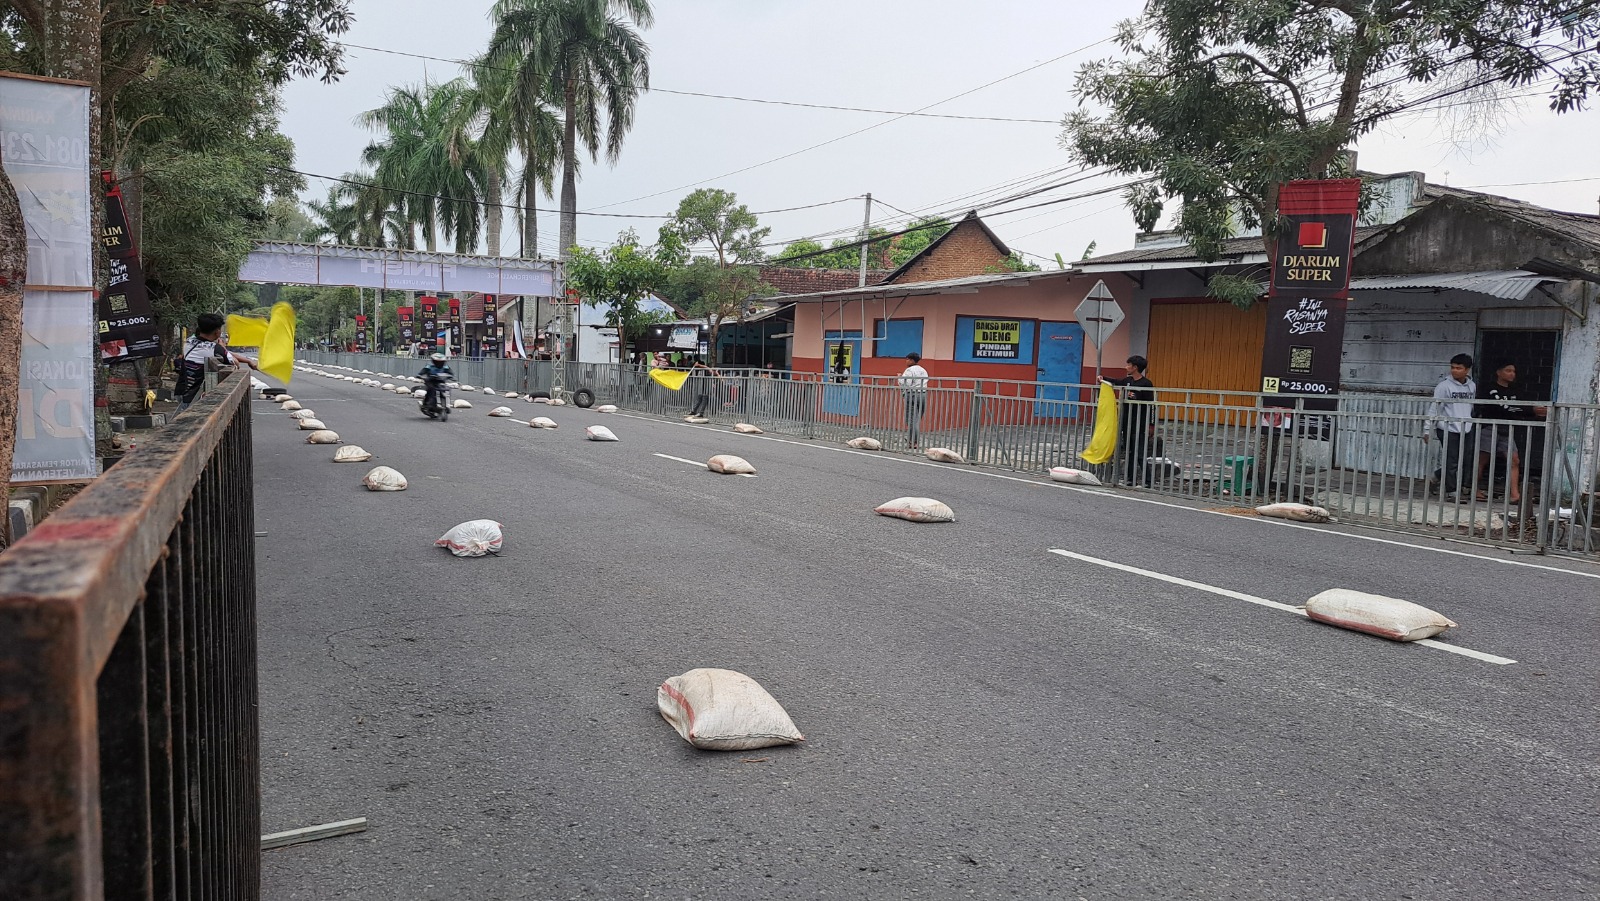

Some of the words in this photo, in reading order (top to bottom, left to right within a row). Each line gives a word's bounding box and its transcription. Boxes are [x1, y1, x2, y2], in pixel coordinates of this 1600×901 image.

[1283, 255, 1340, 268] DJARUM
[1287, 269, 1332, 281] SUPER
[1299, 298, 1323, 310] #INI
[117, 316, 150, 327] 25.000,-
[1283, 309, 1328, 323] RASANYA
[976, 321, 1000, 330] BAKSO
[1001, 322, 1018, 331] URAT
[1289, 321, 1326, 334] SUPER
[982, 331, 1011, 342] DIENG
[980, 343, 1012, 351] PINDAH
[1266, 379, 1276, 388] 12
[1290, 381, 1332, 394] 25.000,-
